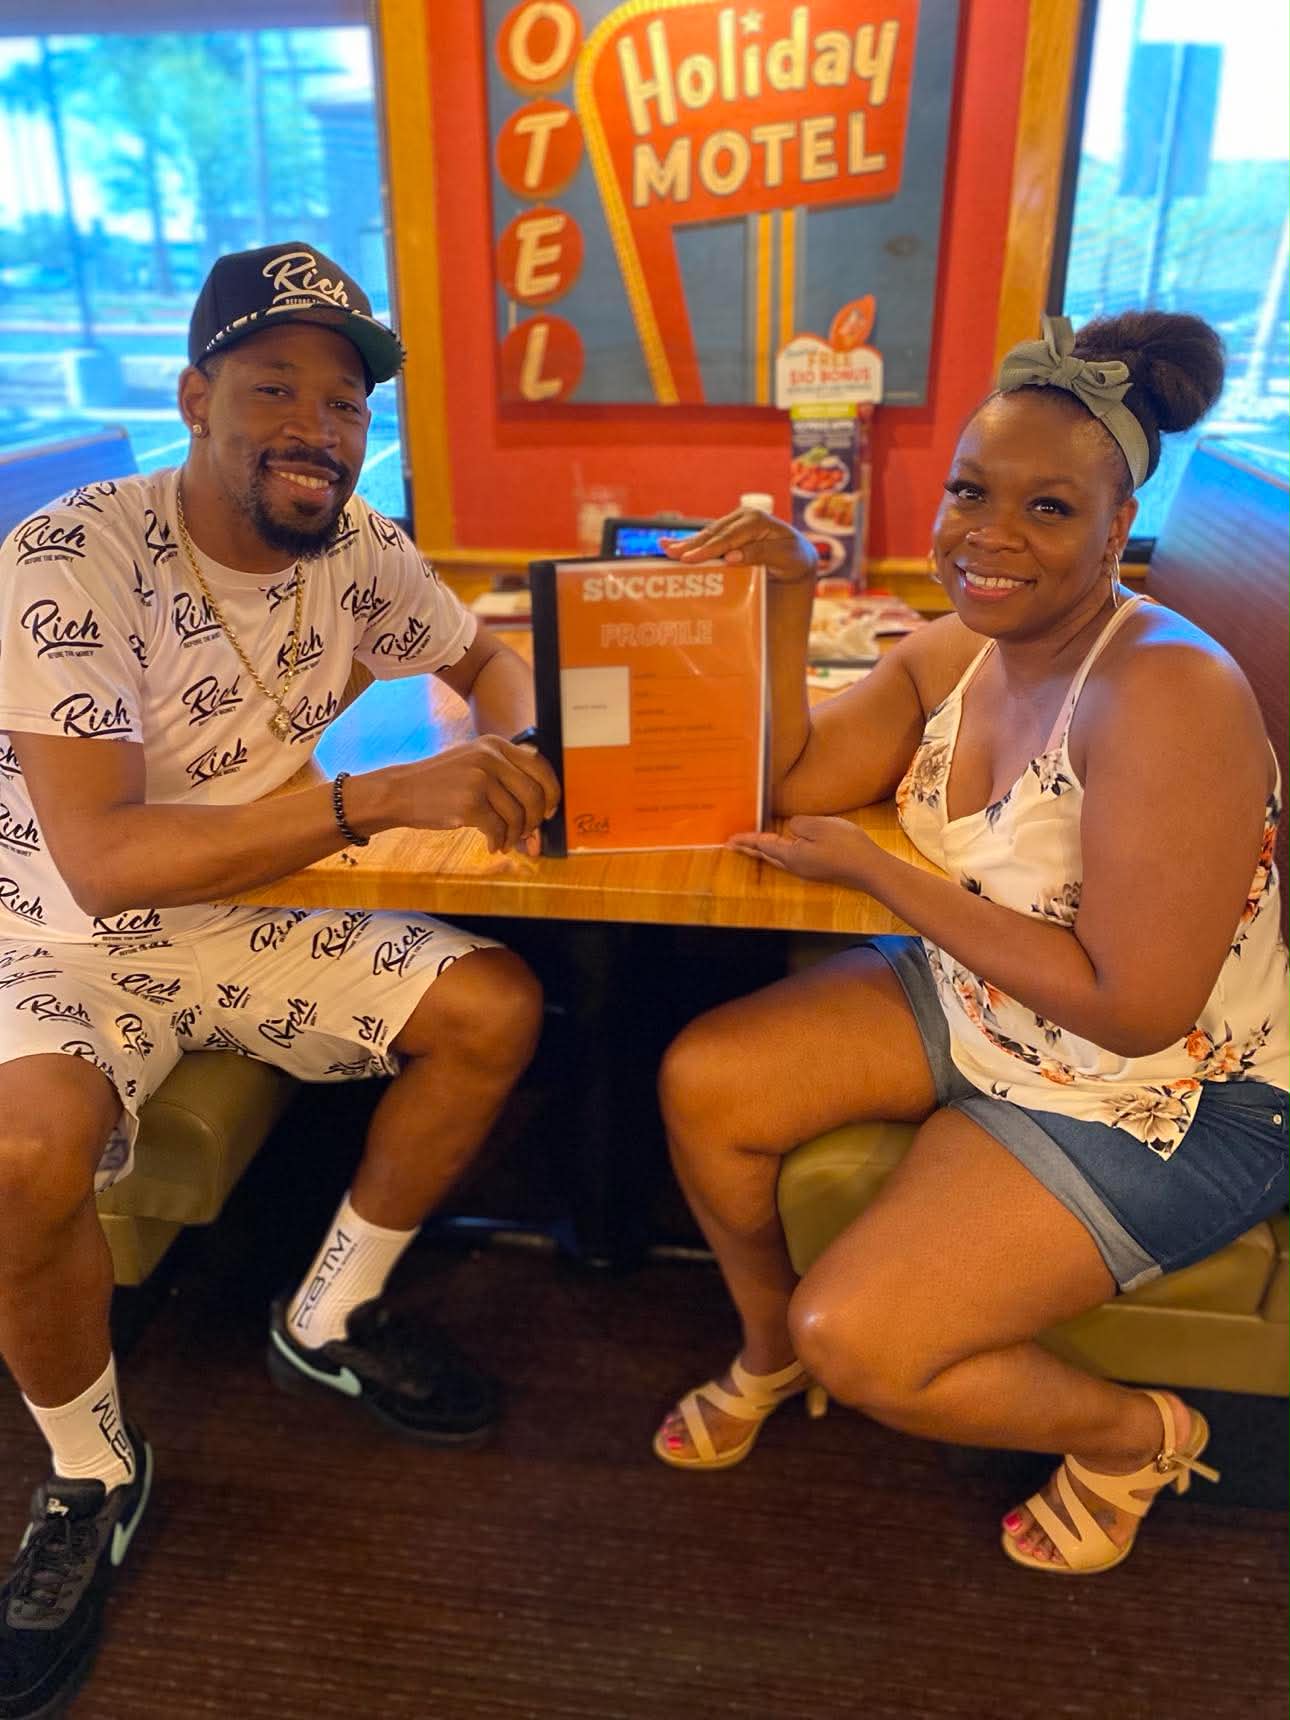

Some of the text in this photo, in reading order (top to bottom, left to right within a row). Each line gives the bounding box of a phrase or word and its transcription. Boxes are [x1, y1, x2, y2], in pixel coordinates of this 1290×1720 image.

[617, 5, 899, 136] Holiday
[633, 111, 886, 207] MOTEL
[263, 252, 350, 308] Rich
[14, 515, 86, 563] Rich
[583, 573, 723, 601] SUCCESS
[21, 600, 104, 658] Rich
[601, 620, 712, 648] PROFILE
[51, 693, 132, 738] Rich
[186, 738, 247, 787] Rich
[312, 911, 373, 960] Rich
[373, 925, 434, 977] Rich
[16, 994, 94, 1026] Rich
[111, 973, 181, 1001] Rich
